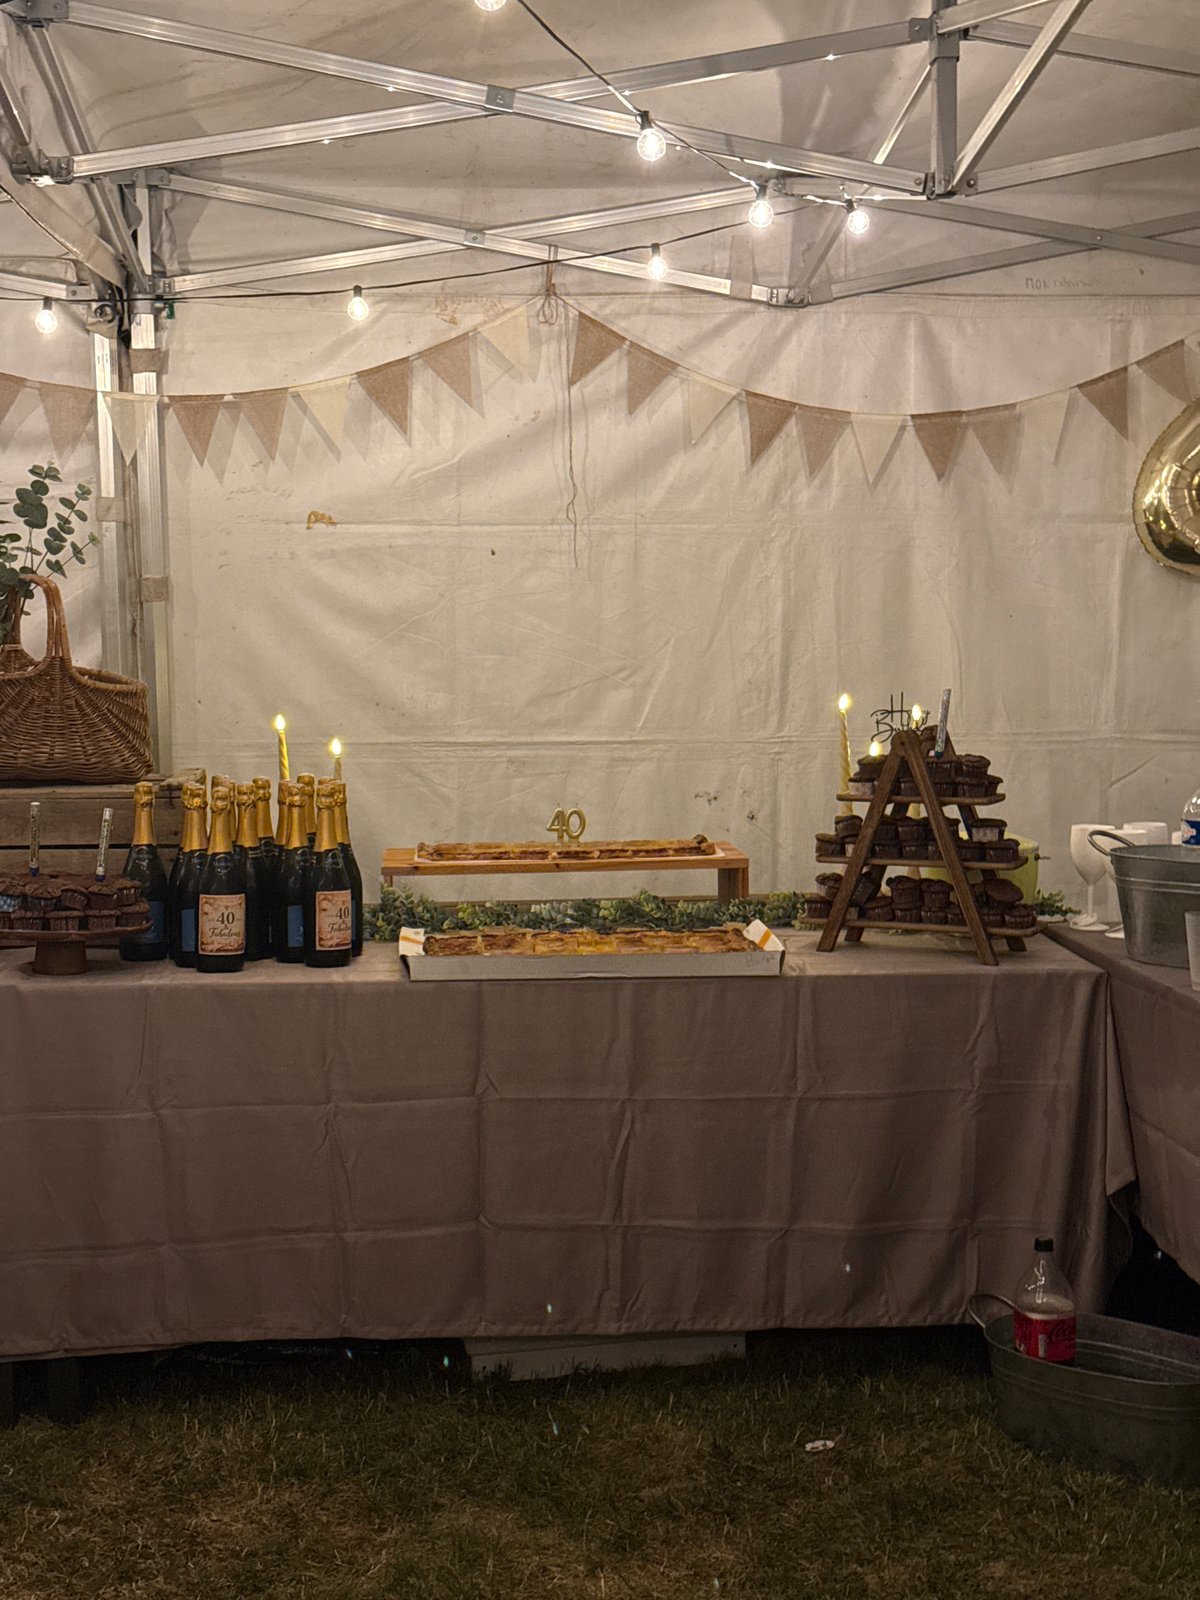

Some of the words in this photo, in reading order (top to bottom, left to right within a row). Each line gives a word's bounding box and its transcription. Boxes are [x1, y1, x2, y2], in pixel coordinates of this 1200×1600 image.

[546, 807, 586, 841] 40
[216, 911, 235, 925] 40
[336, 907, 350, 919] 40
[208, 927, 241, 938] Fabulous
